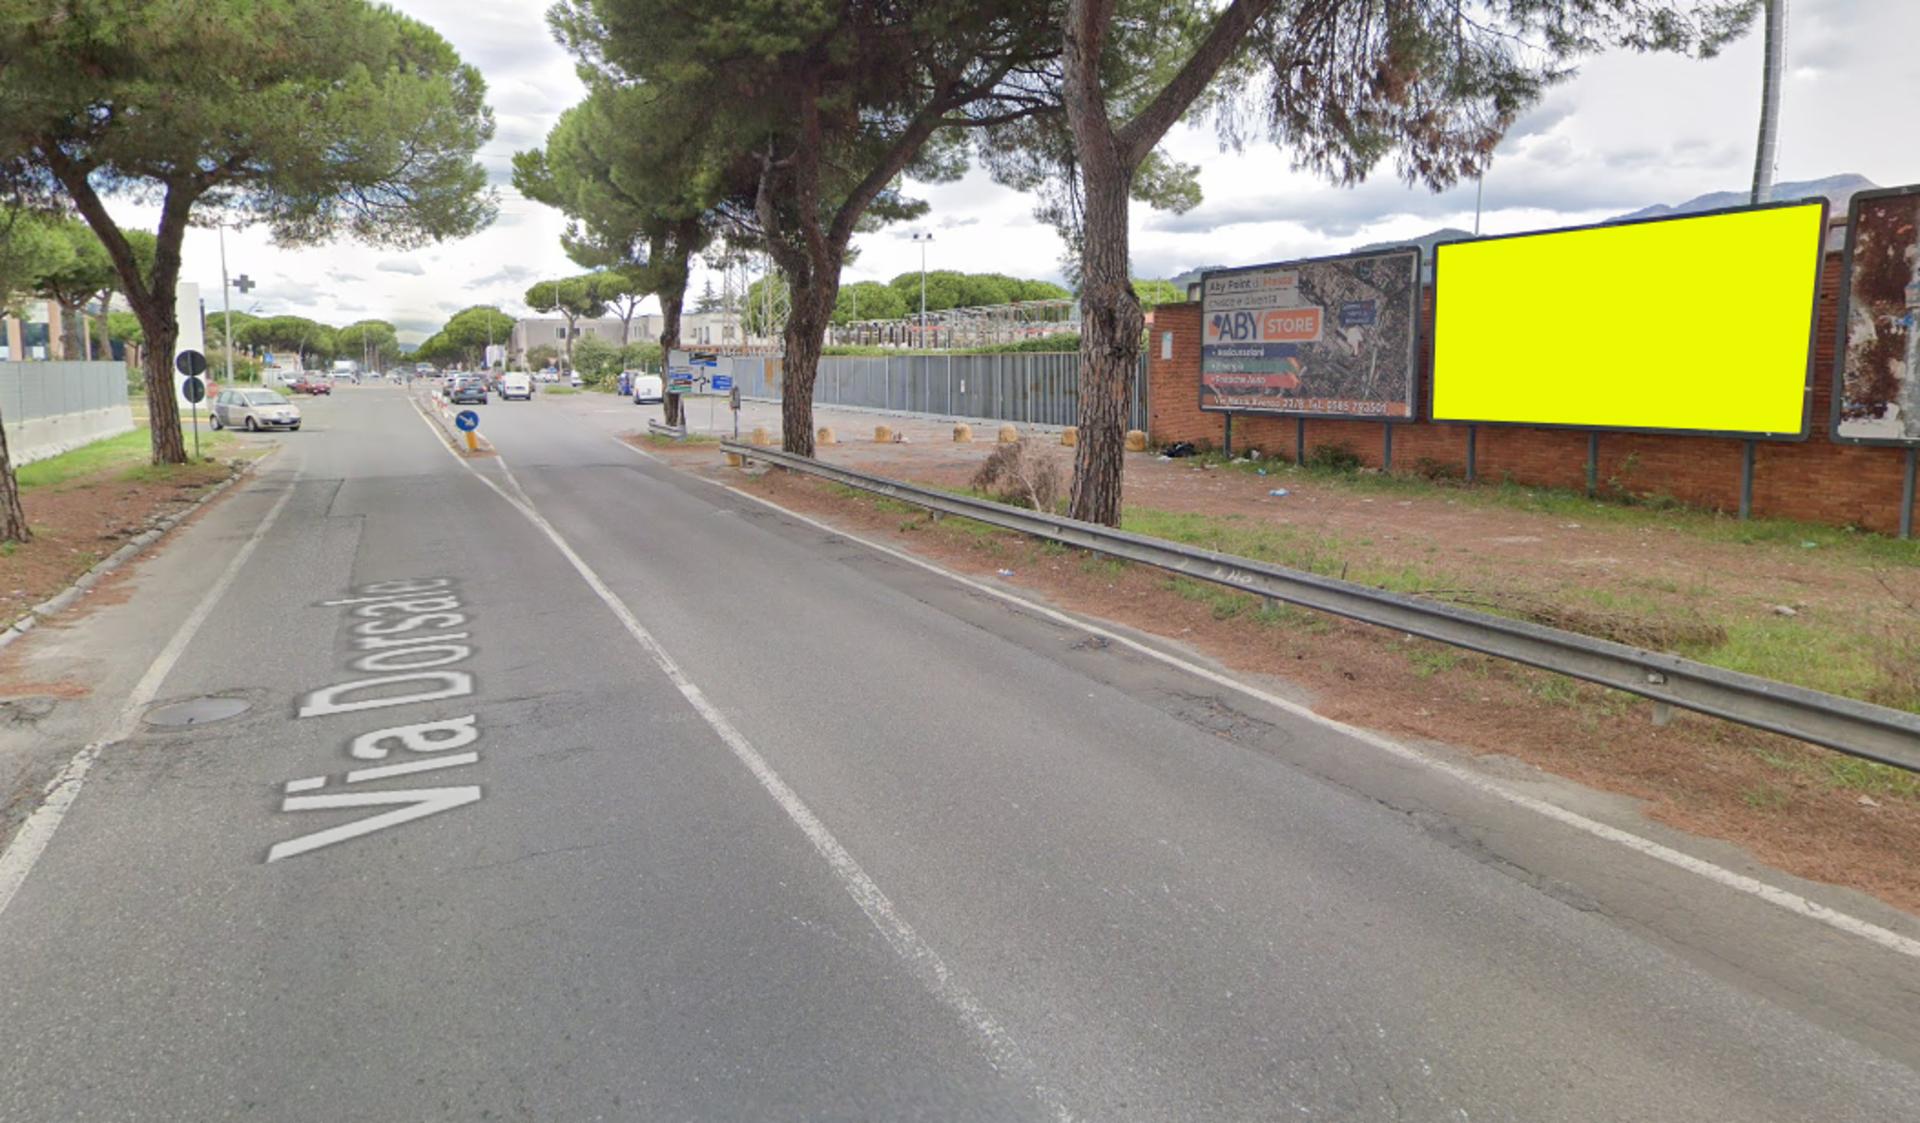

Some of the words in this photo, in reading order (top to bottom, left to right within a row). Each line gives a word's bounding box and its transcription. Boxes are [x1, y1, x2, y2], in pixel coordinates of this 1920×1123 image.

[1209, 281, 1226, 293] Aby
[1219, 311, 1264, 341] ABY
[1267, 316, 1314, 334] STORE
